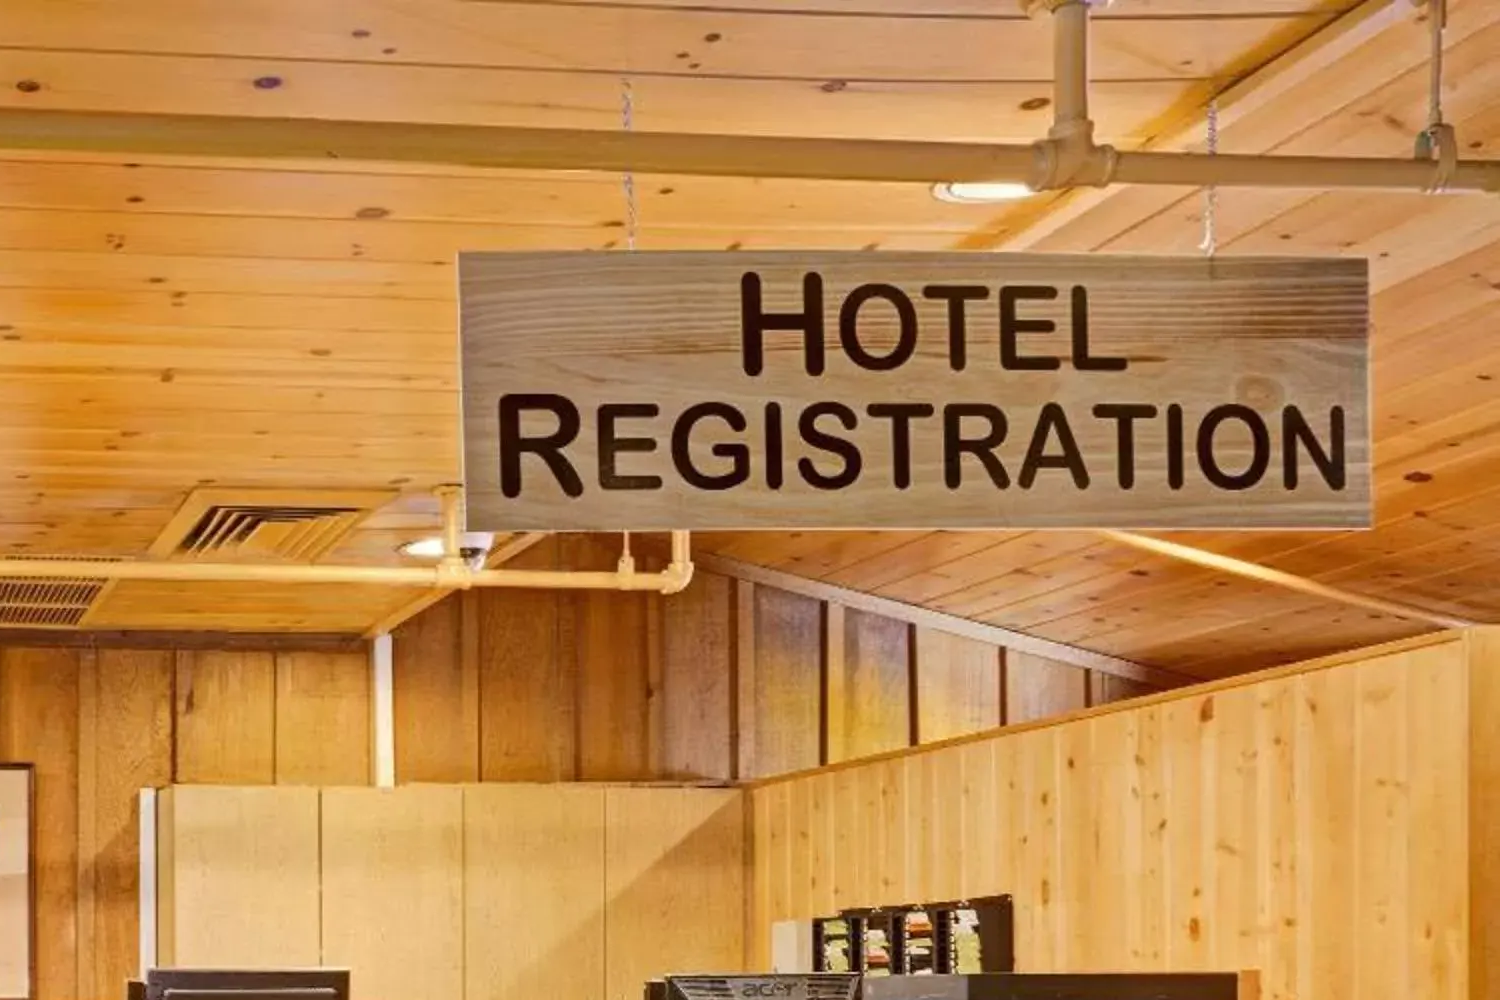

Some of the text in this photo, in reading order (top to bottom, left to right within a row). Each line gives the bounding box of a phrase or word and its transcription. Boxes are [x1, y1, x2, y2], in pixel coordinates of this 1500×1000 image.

[740, 271, 1129, 377] HOTEL
[499, 393, 1347, 499] REGISTRATION
[743, 981, 798, 997] acer
